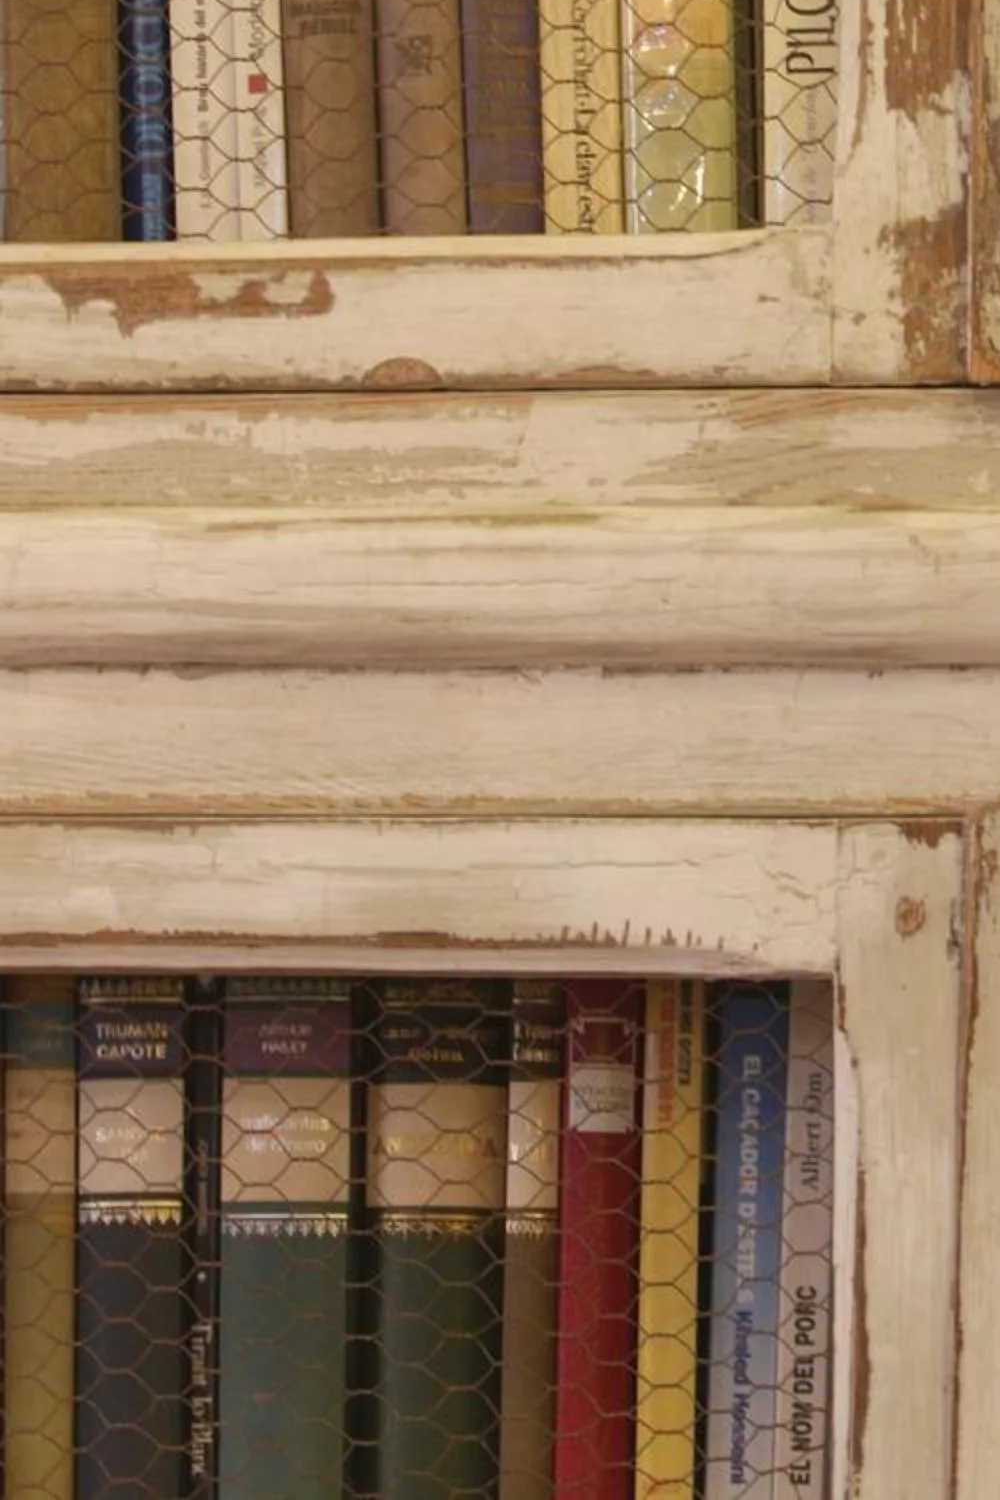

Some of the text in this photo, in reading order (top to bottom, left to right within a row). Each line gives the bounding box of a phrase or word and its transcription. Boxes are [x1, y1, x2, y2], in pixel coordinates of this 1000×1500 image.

[95, 1023, 169, 1040] TRUMAN
[95, 1042, 168, 1061] CAPOTE
[743, 1055, 761, 1079] EL
[800, 1121, 822, 1191] Albert
[794, 1285, 817, 1347] PORC
[792, 1355, 814, 1394] DEL
[790, 1401, 813, 1451] NOM
[790, 1458, 812, 1486] EL
